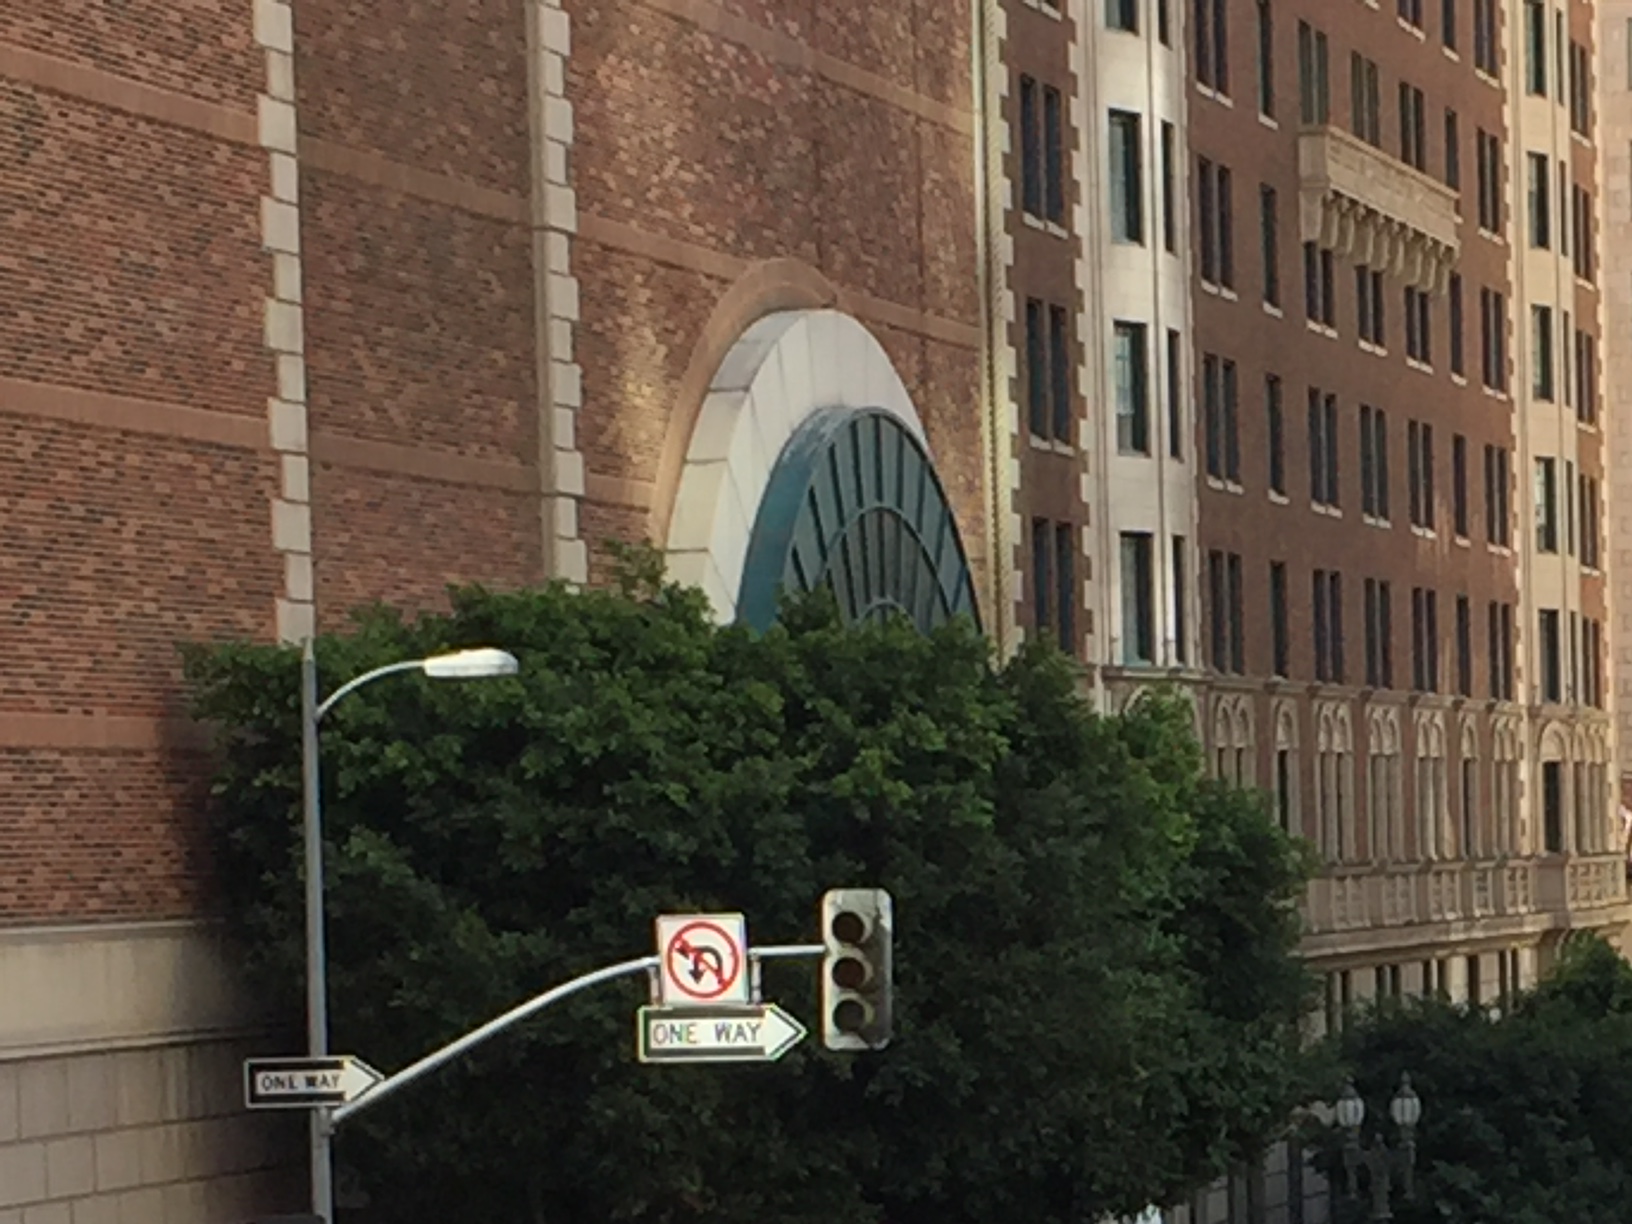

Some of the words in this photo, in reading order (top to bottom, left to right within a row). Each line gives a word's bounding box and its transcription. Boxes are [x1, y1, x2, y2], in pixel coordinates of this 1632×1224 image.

[653, 1023, 698, 1045] ONE
[714, 1022, 761, 1043] WAY
[262, 1075, 298, 1091] ONE
[304, 1074, 340, 1089] WAY
